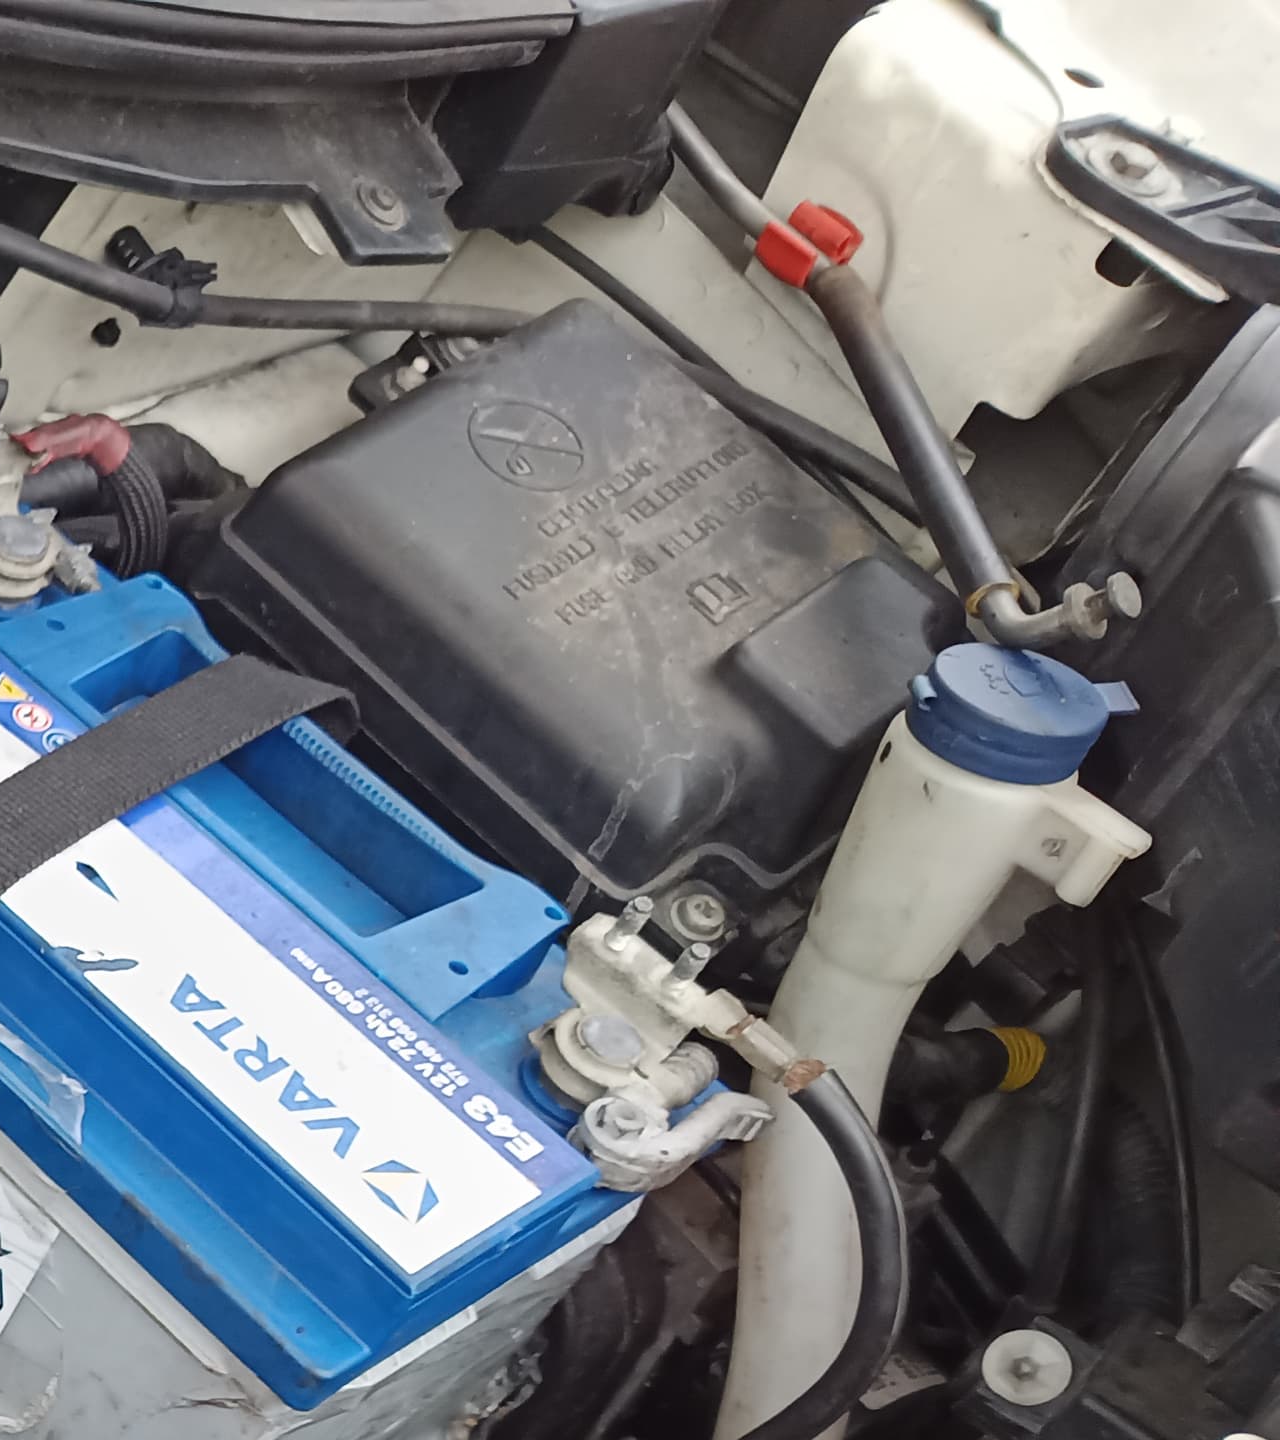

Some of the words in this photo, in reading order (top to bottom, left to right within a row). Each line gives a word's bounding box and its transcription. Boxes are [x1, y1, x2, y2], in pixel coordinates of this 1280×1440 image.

[170, 973, 360, 1159] VARTA
[365, 1014, 417, 1061] 72Ah
[414, 1062, 458, 1097] 12V
[463, 1094, 545, 1162] E43
